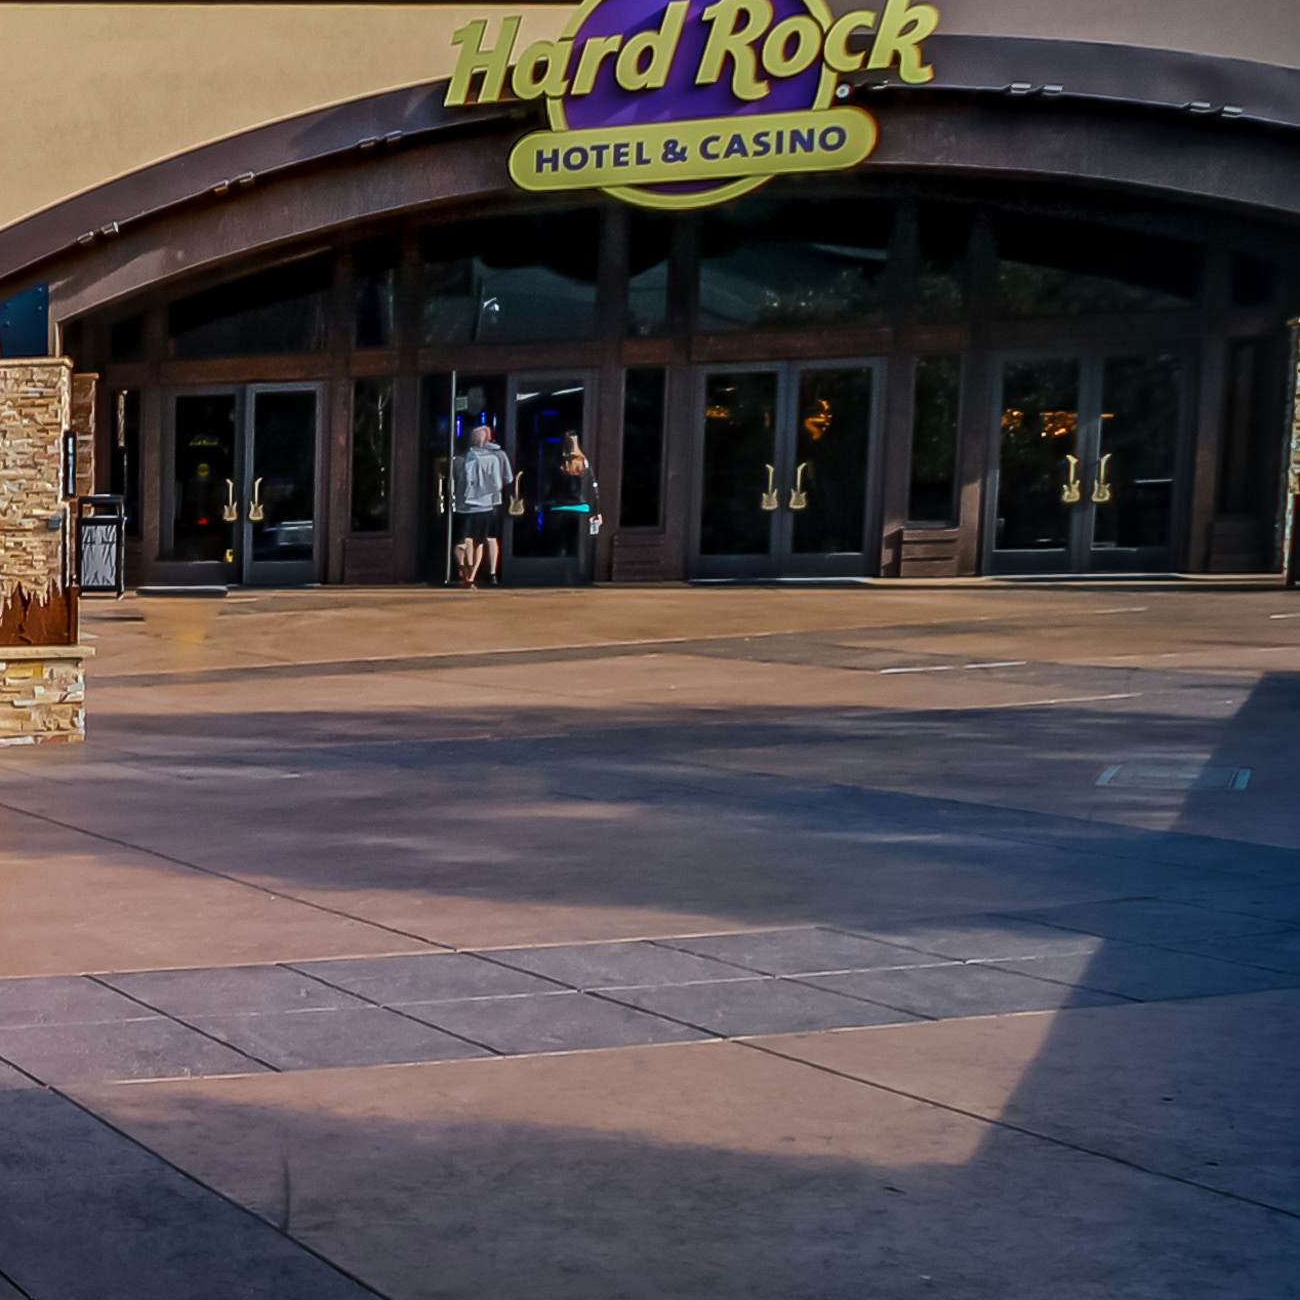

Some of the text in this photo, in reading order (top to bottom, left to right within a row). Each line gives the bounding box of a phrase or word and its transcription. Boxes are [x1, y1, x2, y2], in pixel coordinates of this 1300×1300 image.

[444, 0, 689, 106] Hard
[535, 125, 846, 173] HOTEL & CASINO
